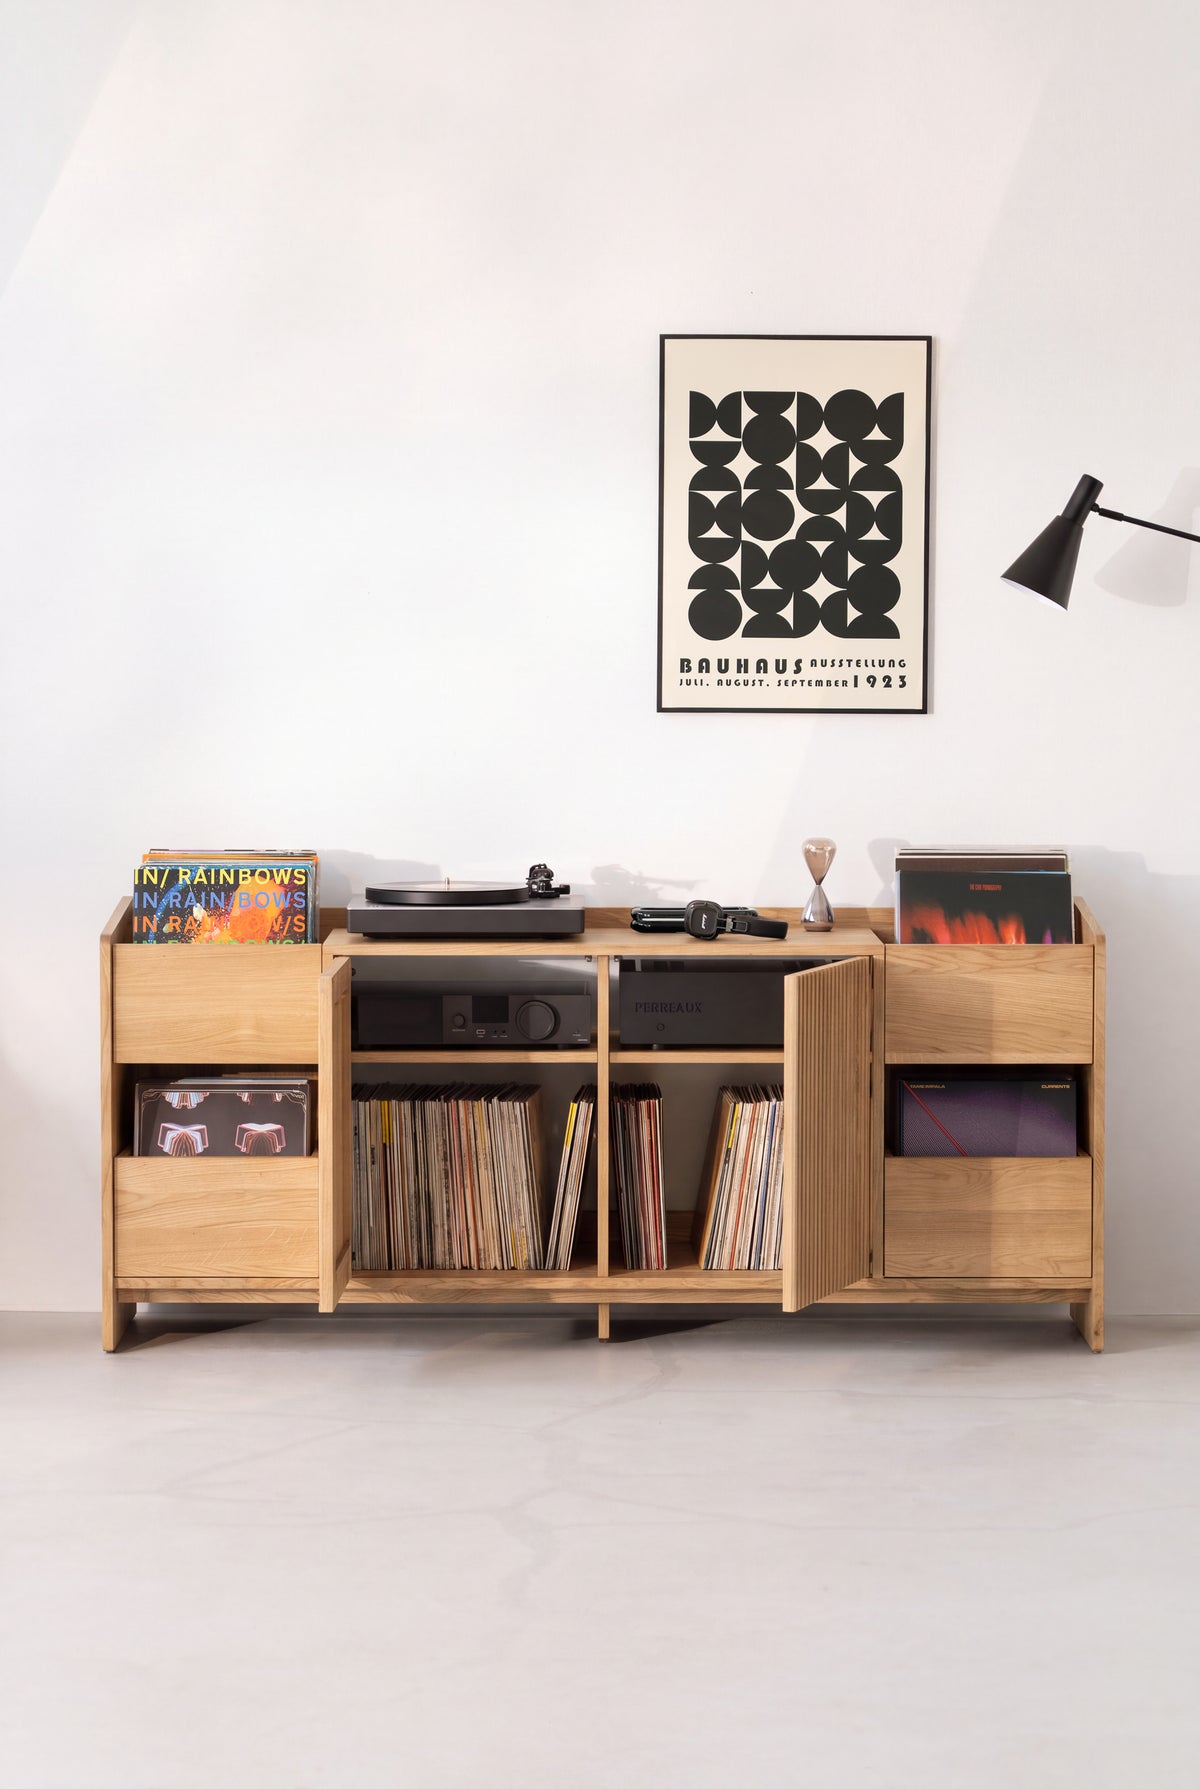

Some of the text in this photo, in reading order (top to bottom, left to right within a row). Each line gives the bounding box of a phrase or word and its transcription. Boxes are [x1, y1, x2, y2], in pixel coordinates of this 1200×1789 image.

[680, 658, 907, 674] BAUHAUS AUSSTELLUNG
[679, 679, 710, 687] JULI.
[777, 679, 849, 687] SEPTEMBER
[853, 675, 907, 688] 1923
[134, 868, 306, 888] IN/ RAINBOWS
[134, 891, 306, 911] IN RAIN/BOWS
[133, 916, 157, 932] IN
[635, 1002, 702, 1013] PERREAUX
